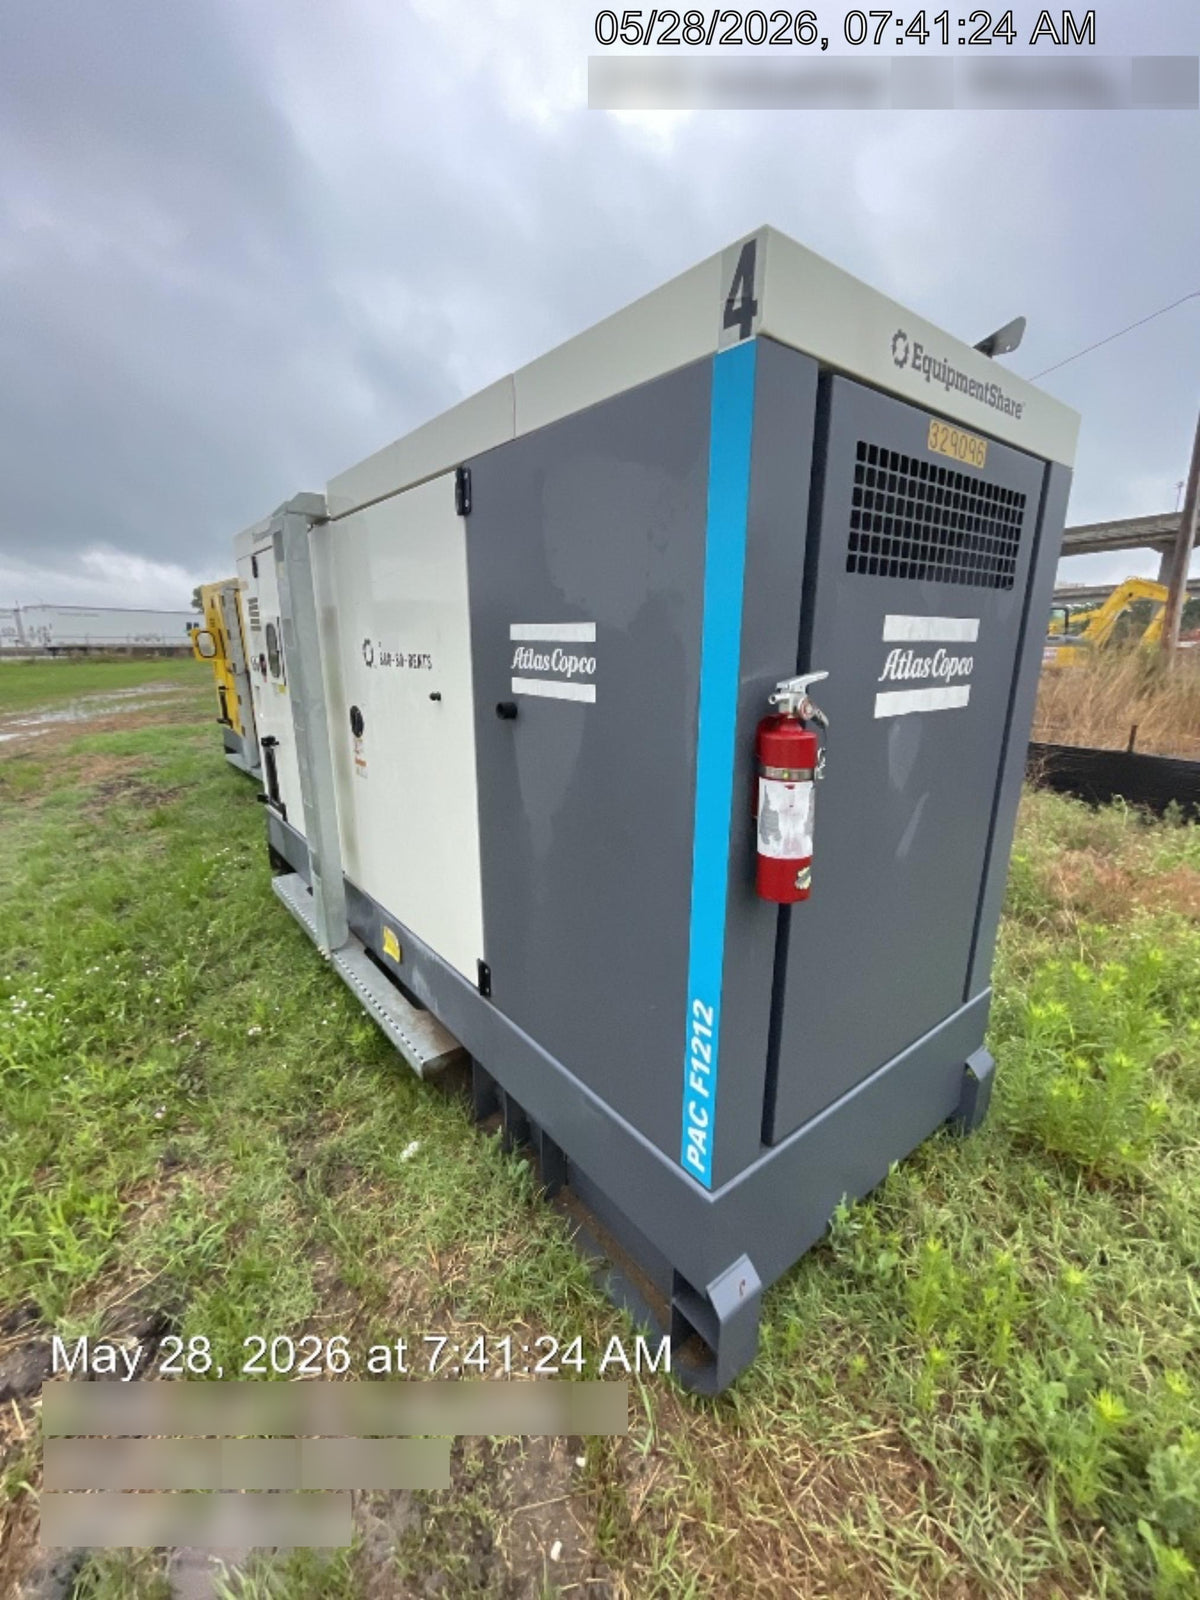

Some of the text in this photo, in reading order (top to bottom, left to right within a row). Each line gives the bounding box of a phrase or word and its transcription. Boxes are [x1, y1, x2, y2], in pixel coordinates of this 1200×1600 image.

[723, 238, 758, 341] 4
[911, 342, 1023, 420] EquipmentShare
[930, 422, 984, 468] 329096
[686, 998, 714, 1173] PAC F1212
